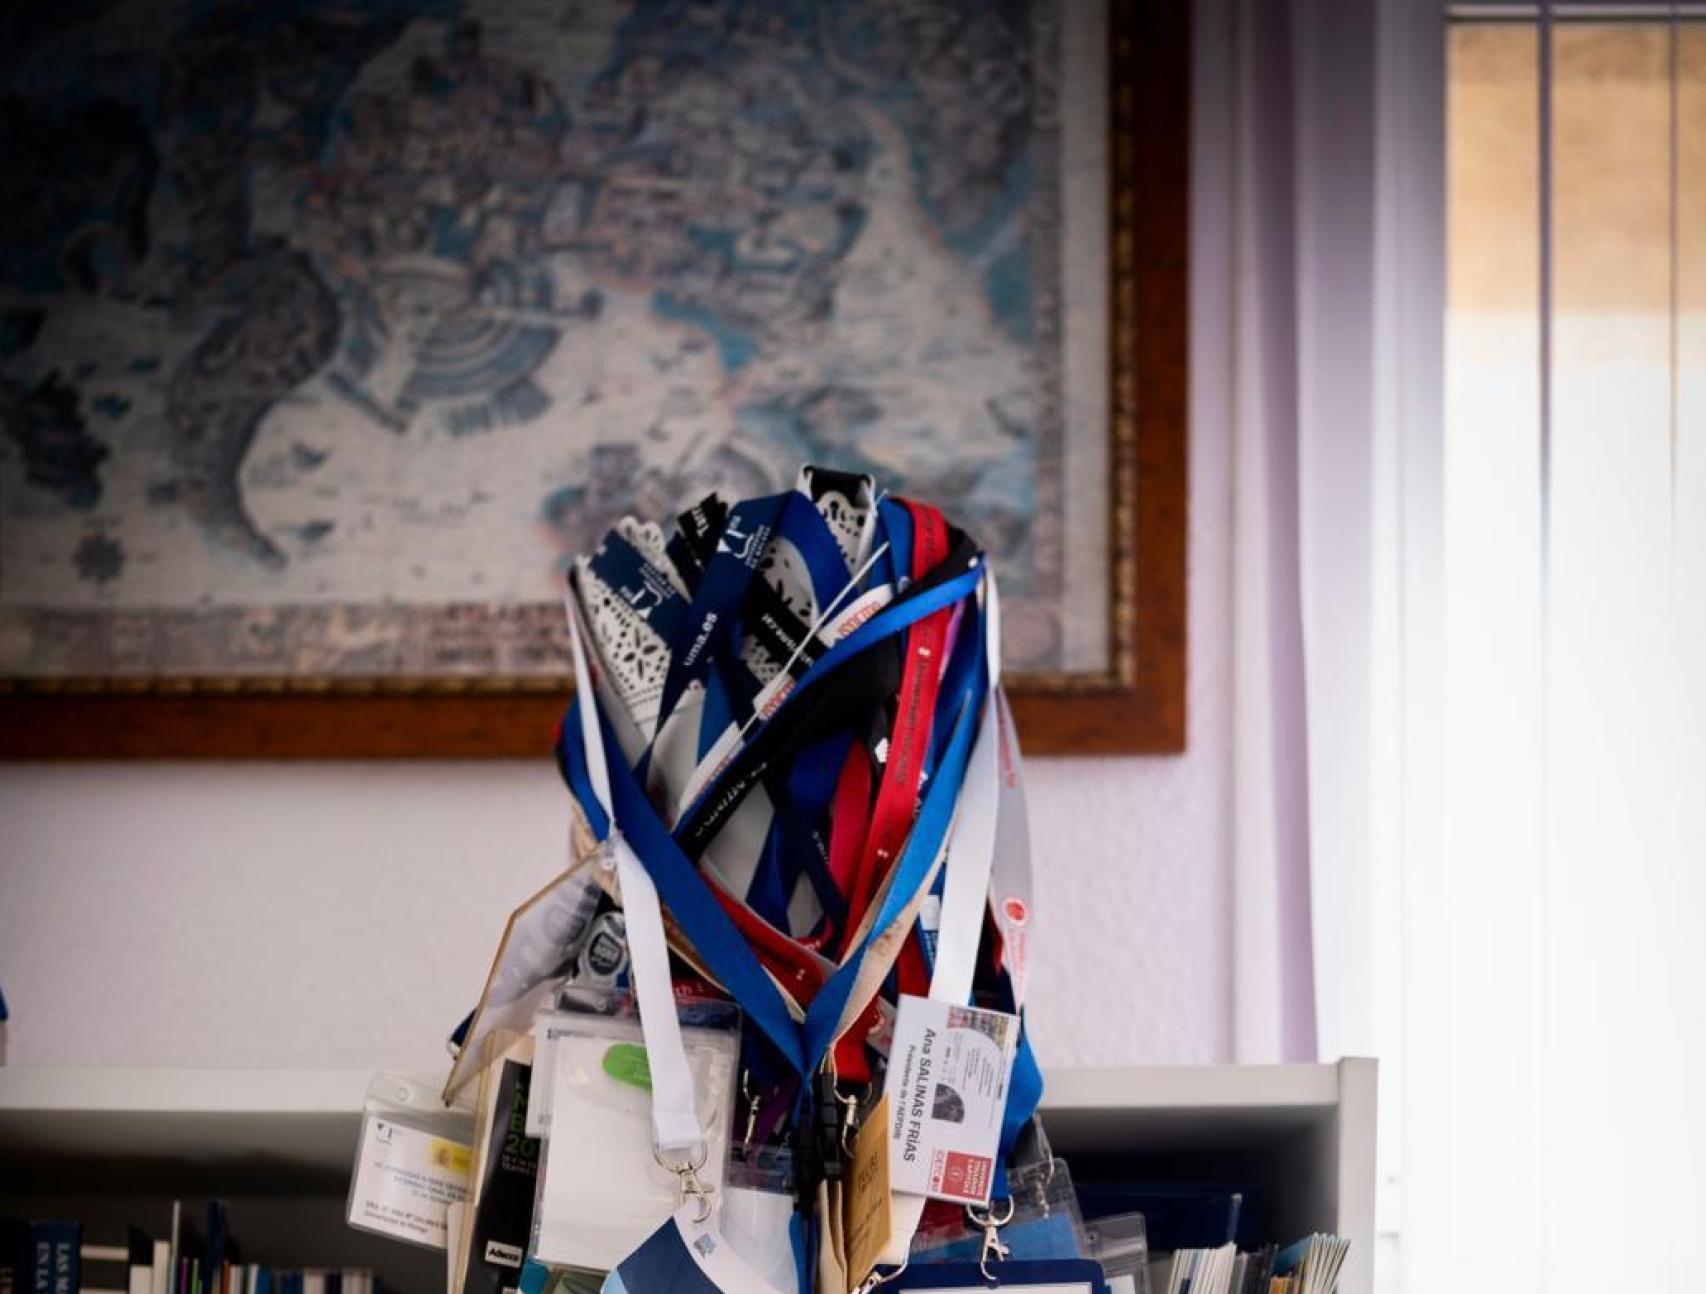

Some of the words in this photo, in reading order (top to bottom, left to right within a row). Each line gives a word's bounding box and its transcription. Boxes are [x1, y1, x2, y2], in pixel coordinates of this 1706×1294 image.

[683, 611, 718, 667] uma.es
[921, 1028, 937, 1055] Ana
[911, 1056, 933, 1119] SALINAS
